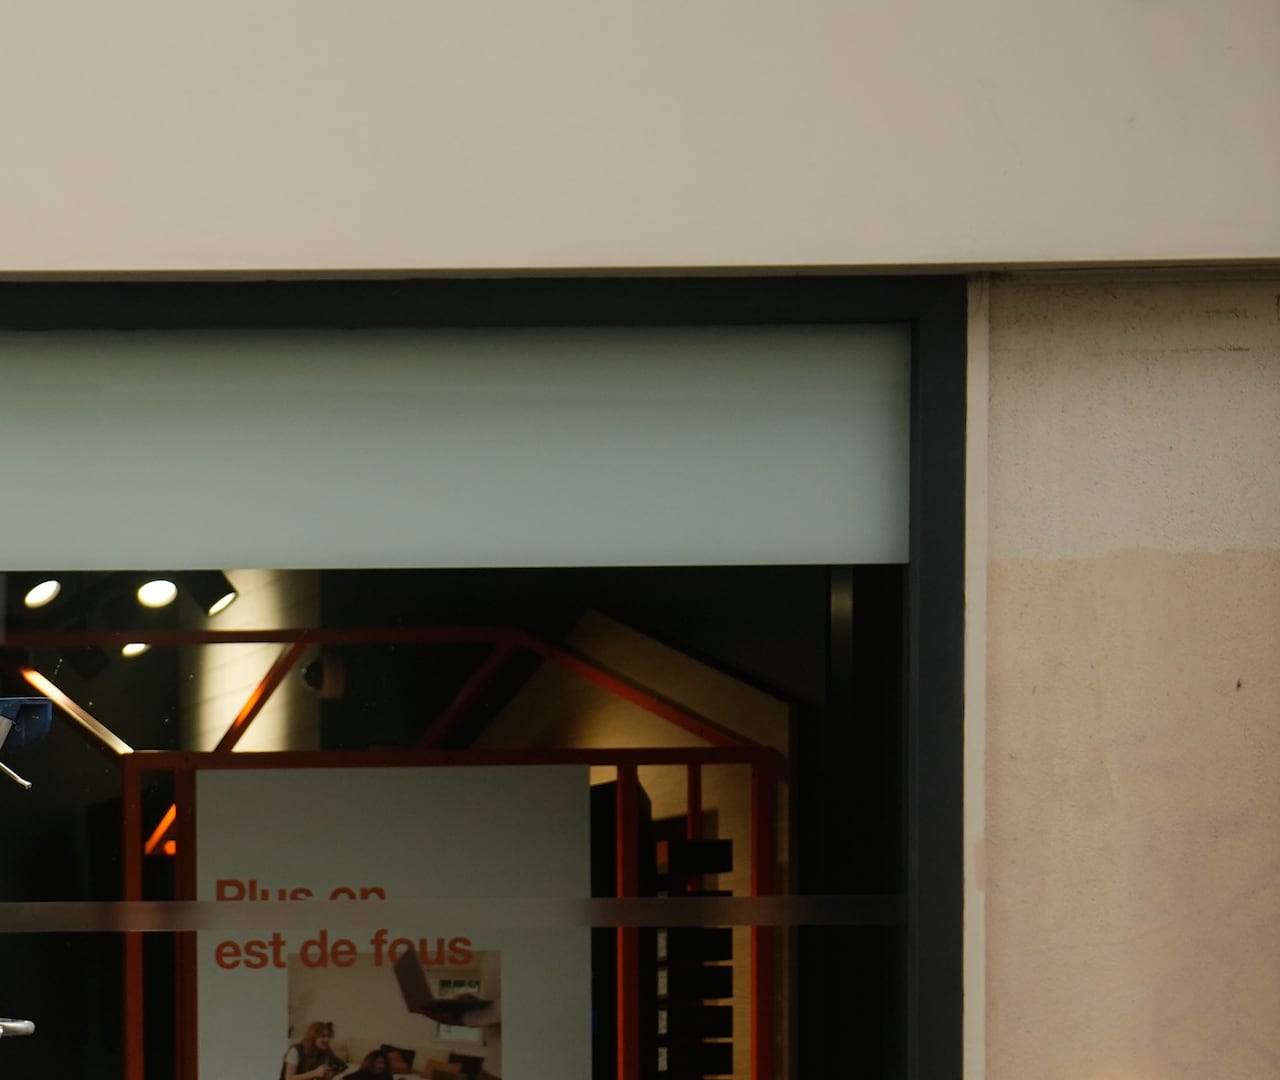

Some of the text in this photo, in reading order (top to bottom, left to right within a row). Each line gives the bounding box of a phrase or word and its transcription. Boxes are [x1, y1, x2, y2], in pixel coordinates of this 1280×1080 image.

[215, 929, 473, 969] est de fous
